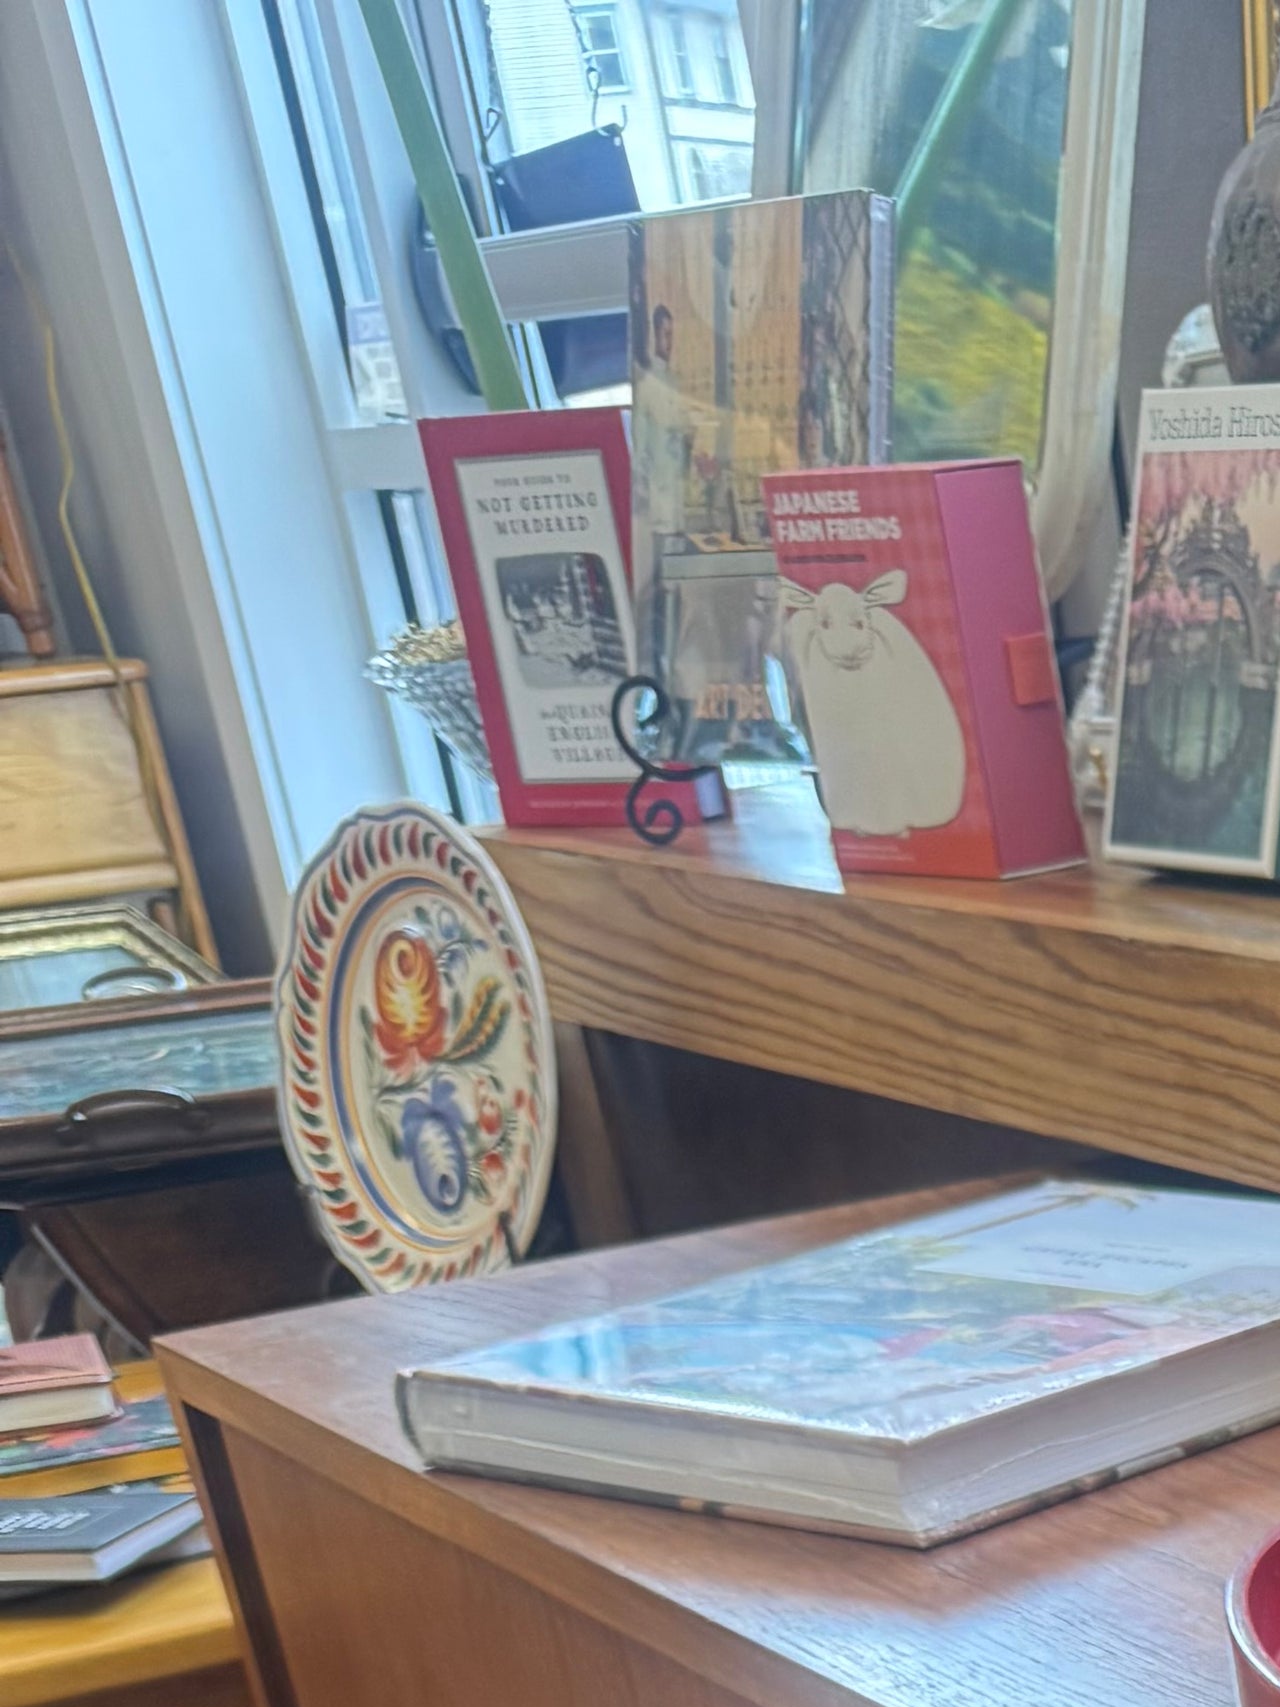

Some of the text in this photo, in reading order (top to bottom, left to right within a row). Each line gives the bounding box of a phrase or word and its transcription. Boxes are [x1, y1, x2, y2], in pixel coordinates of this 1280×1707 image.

[1148, 407, 1222, 440] Yoshida
[477, 492, 599, 514] NOT GETTING
[773, 490, 861, 515] JAPANESE
[494, 516, 590, 535] MURDERED
[776, 516, 902, 542] FARM FRIENDS
